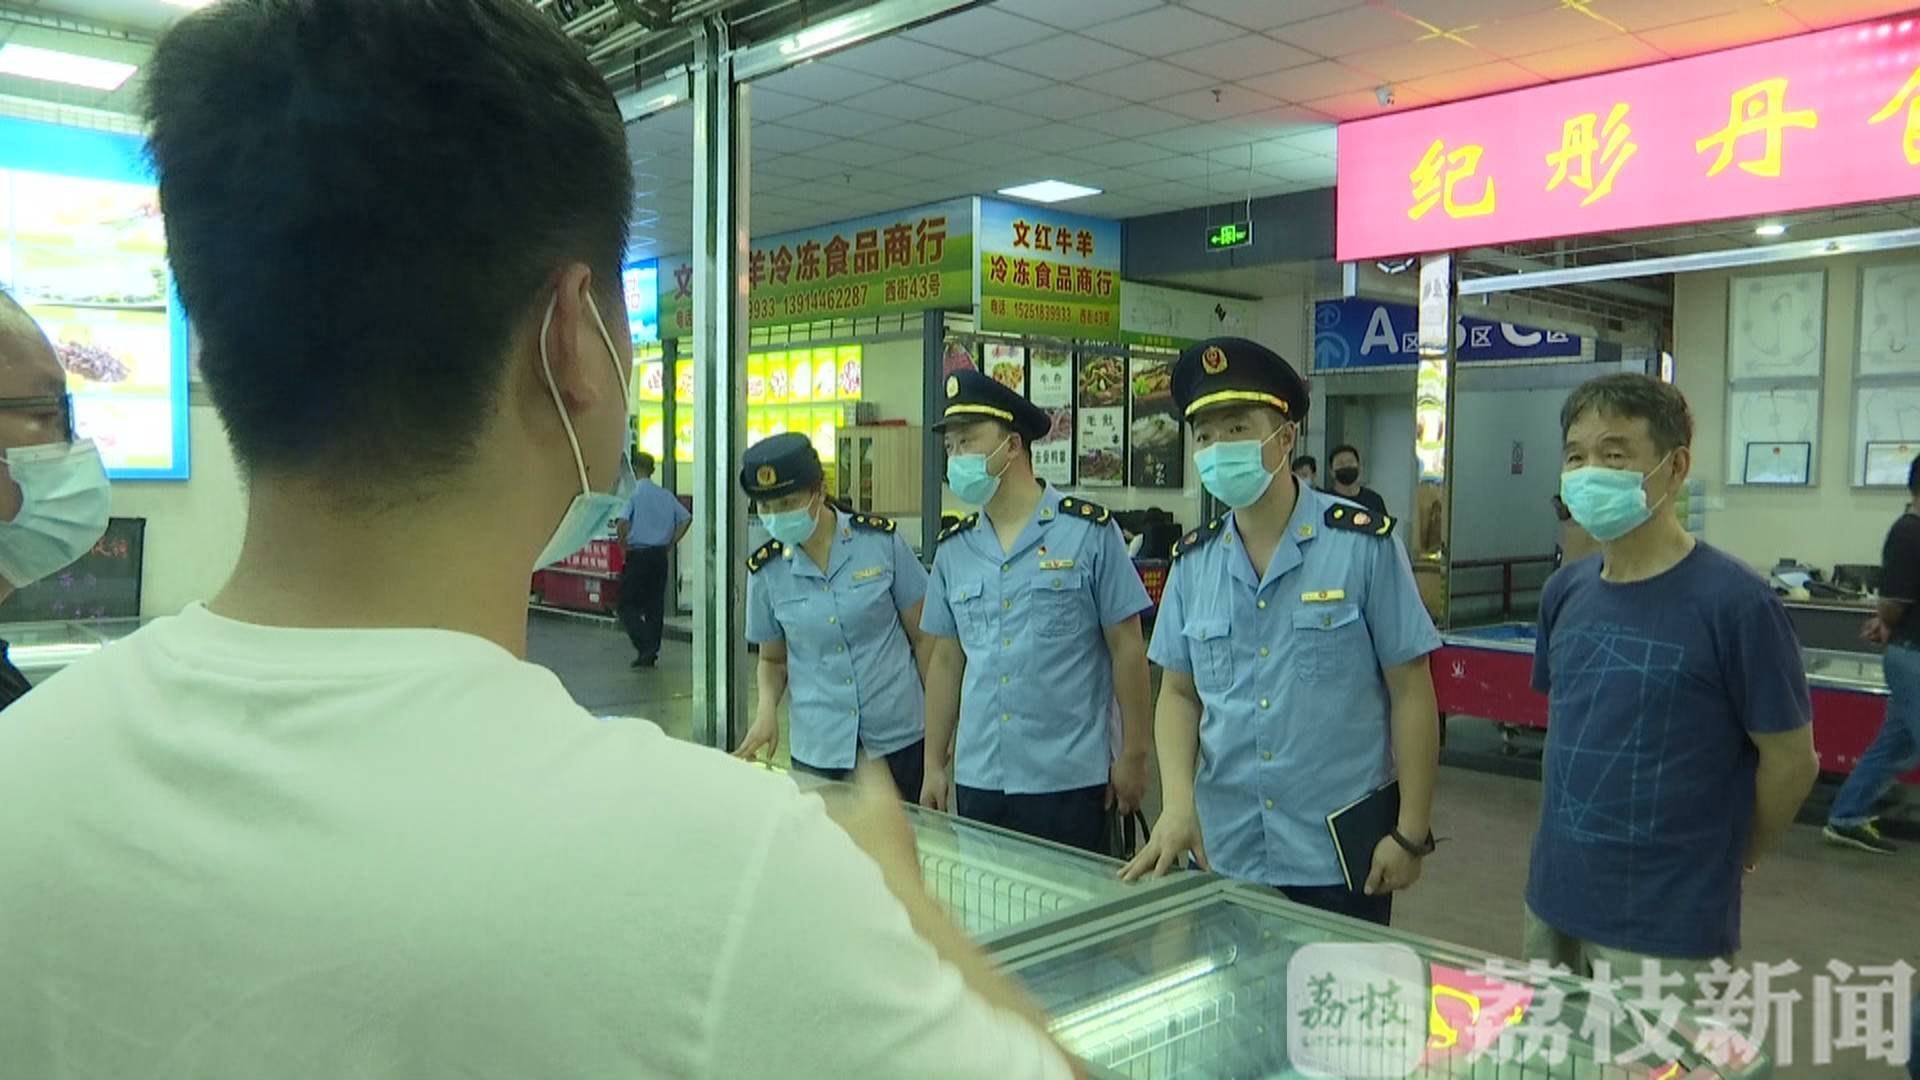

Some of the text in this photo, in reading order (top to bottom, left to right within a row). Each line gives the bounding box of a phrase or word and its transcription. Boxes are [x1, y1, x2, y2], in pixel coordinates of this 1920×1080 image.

[673, 217, 946, 300] 文羊冷冻食品商行
[1012, 219, 1093, 258] 文红牛羊
[784, 284, 868, 315] 13914462287
[885, 273, 941, 303] 西街43号
[990, 255, 1112, 296] 冷冻食品商行
[1014, 302, 1071, 322] 15251839933
